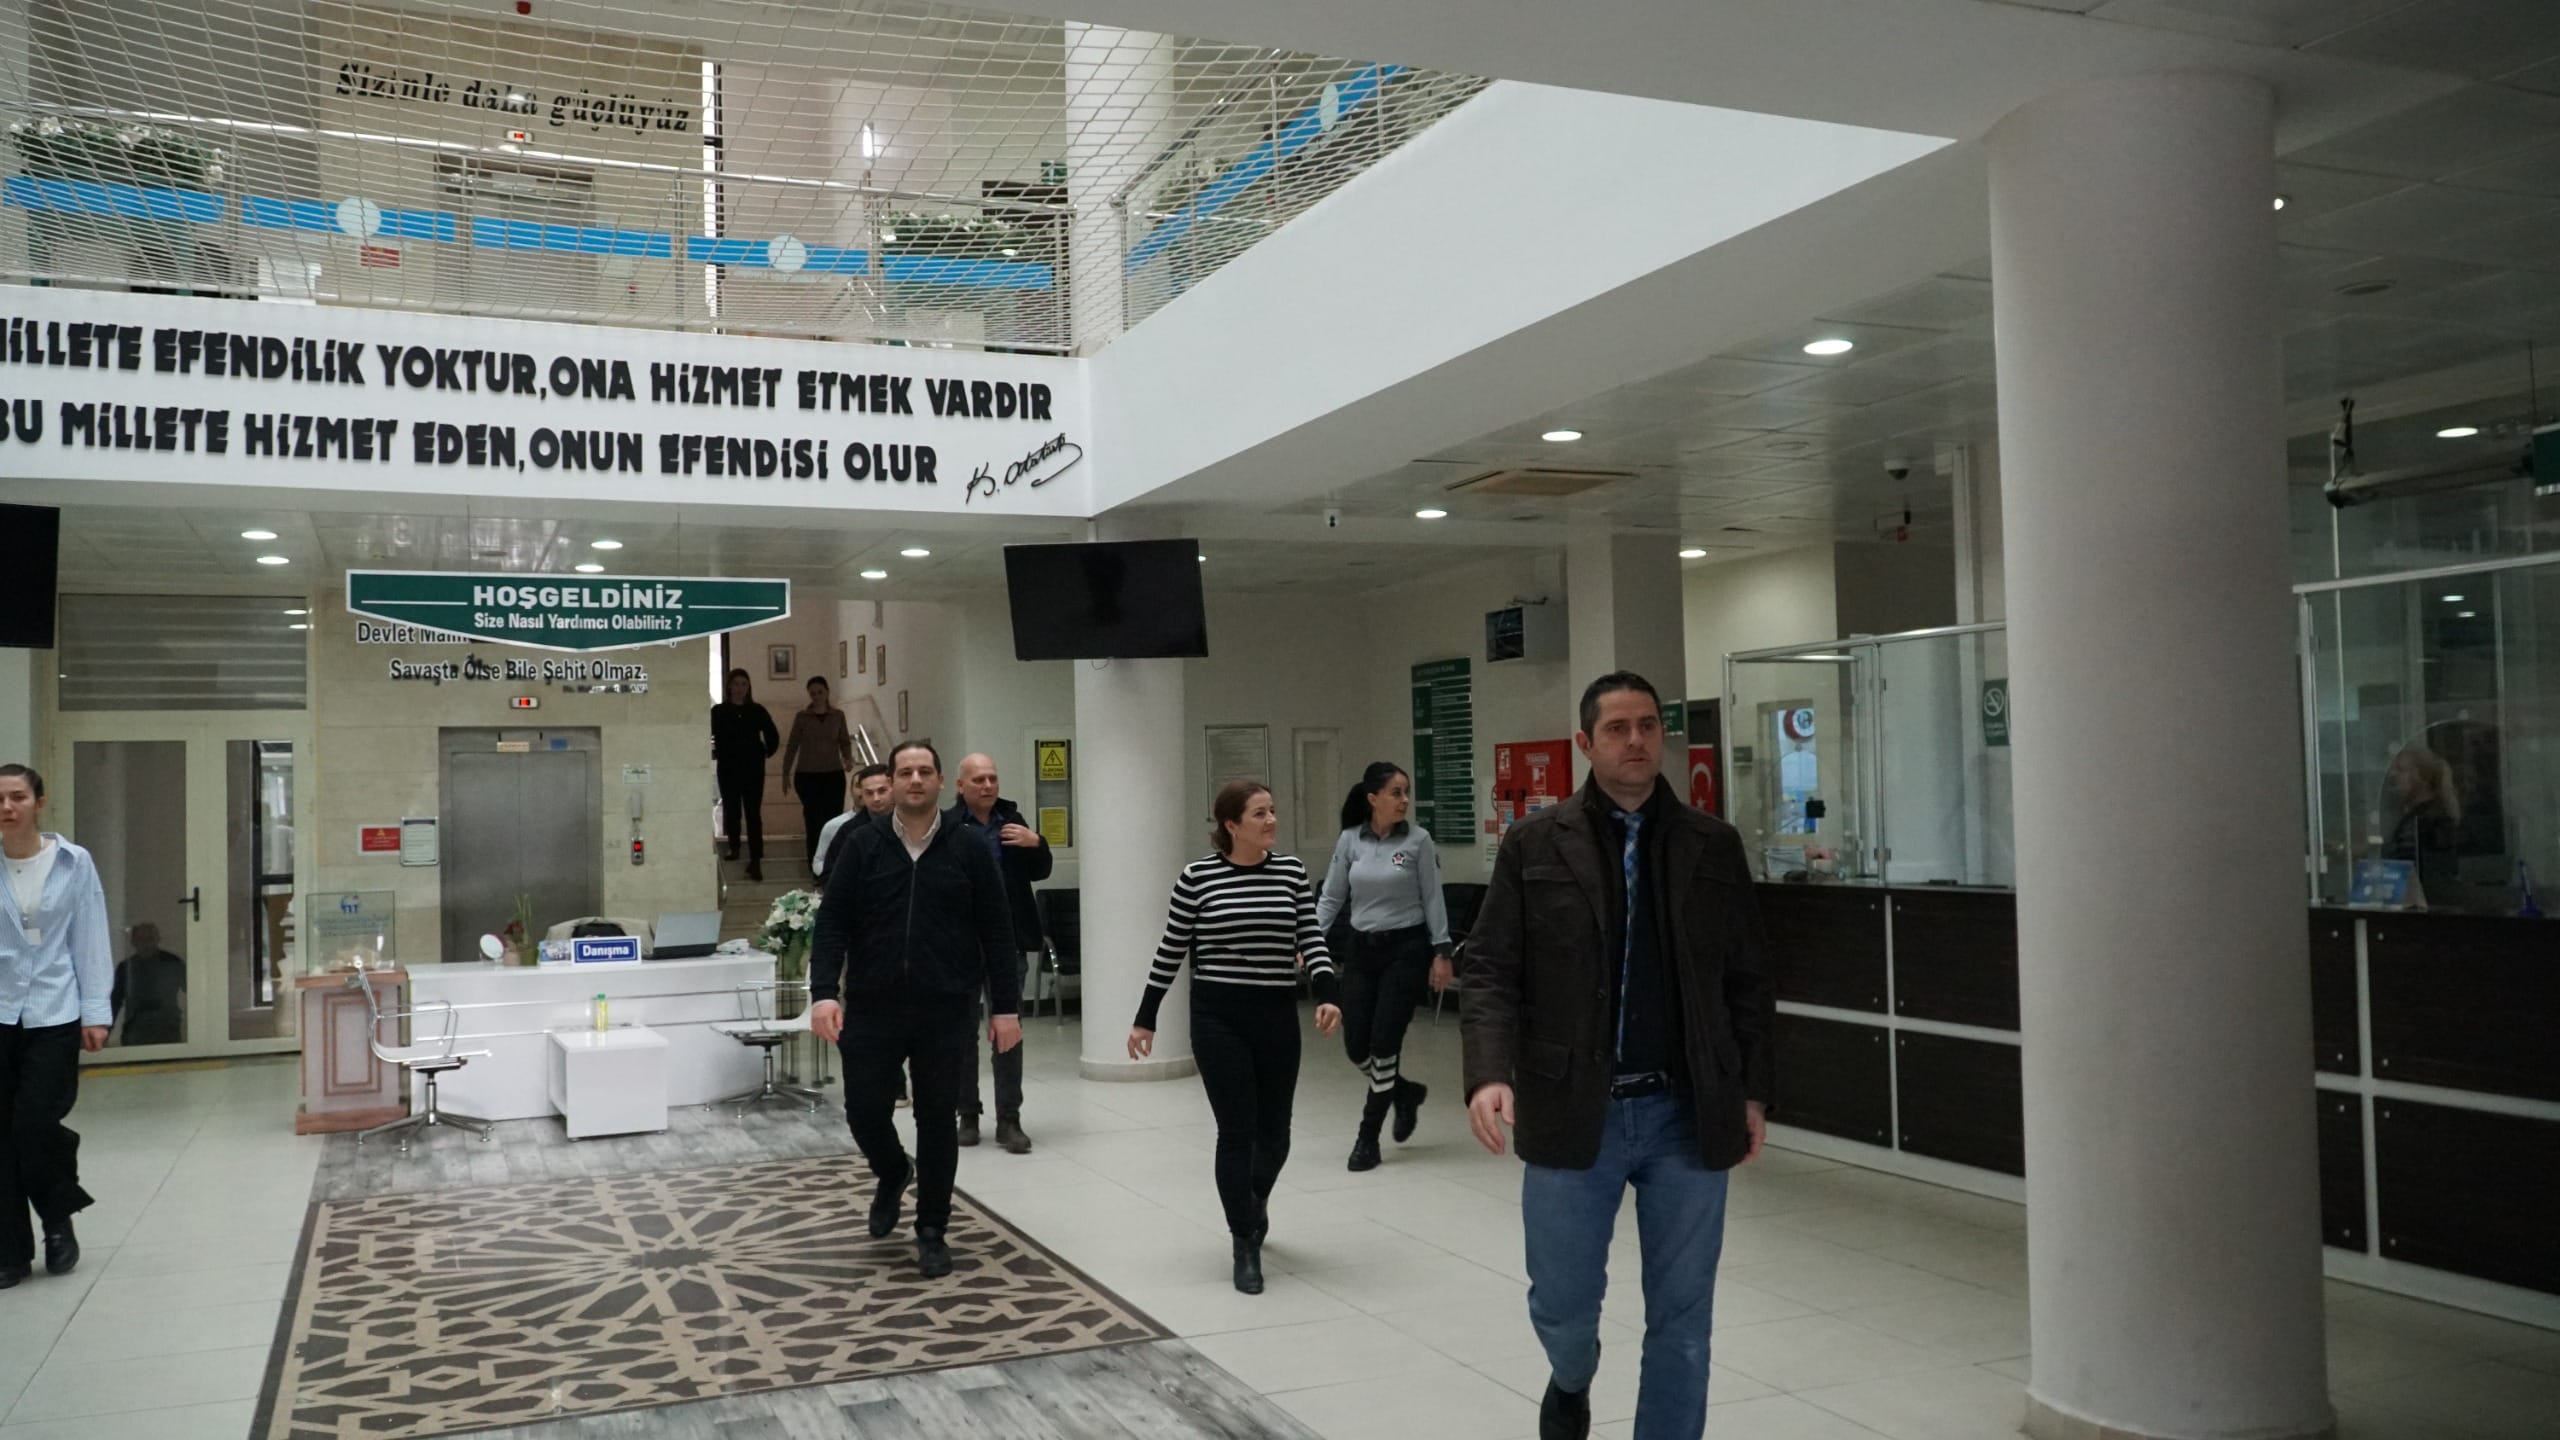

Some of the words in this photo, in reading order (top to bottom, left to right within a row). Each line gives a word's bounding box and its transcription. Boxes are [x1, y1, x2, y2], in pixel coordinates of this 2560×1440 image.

[336, 63, 450, 102] Sizinle
[549, 88, 690, 136] güçlüyüz
[0, 317, 143, 371] İLLETE
[797, 370, 914, 415] ETMEK
[924, 378, 1052, 421] VARDIR
[843, 442, 937, 484] OLUR
[473, 583, 683, 610] HOŞGELDİNİZ
[356, 621, 415, 643] Devlet
[474, 612, 505, 629] Size
[508, 613, 544, 629] Nasıl
[547, 613, 609, 630] Yardımcı
[611, 614, 672, 630] Olabiliriz
[675, 615, 683, 630] ?
[389, 658, 459, 686] Savaşta
[463, 653, 502, 682] Ölse
[505, 658, 538, 681] Bile
[543, 659, 587, 686] Şehit
[591, 659, 648, 681] Olmaz.
[582, 944, 630, 959] Danışma
